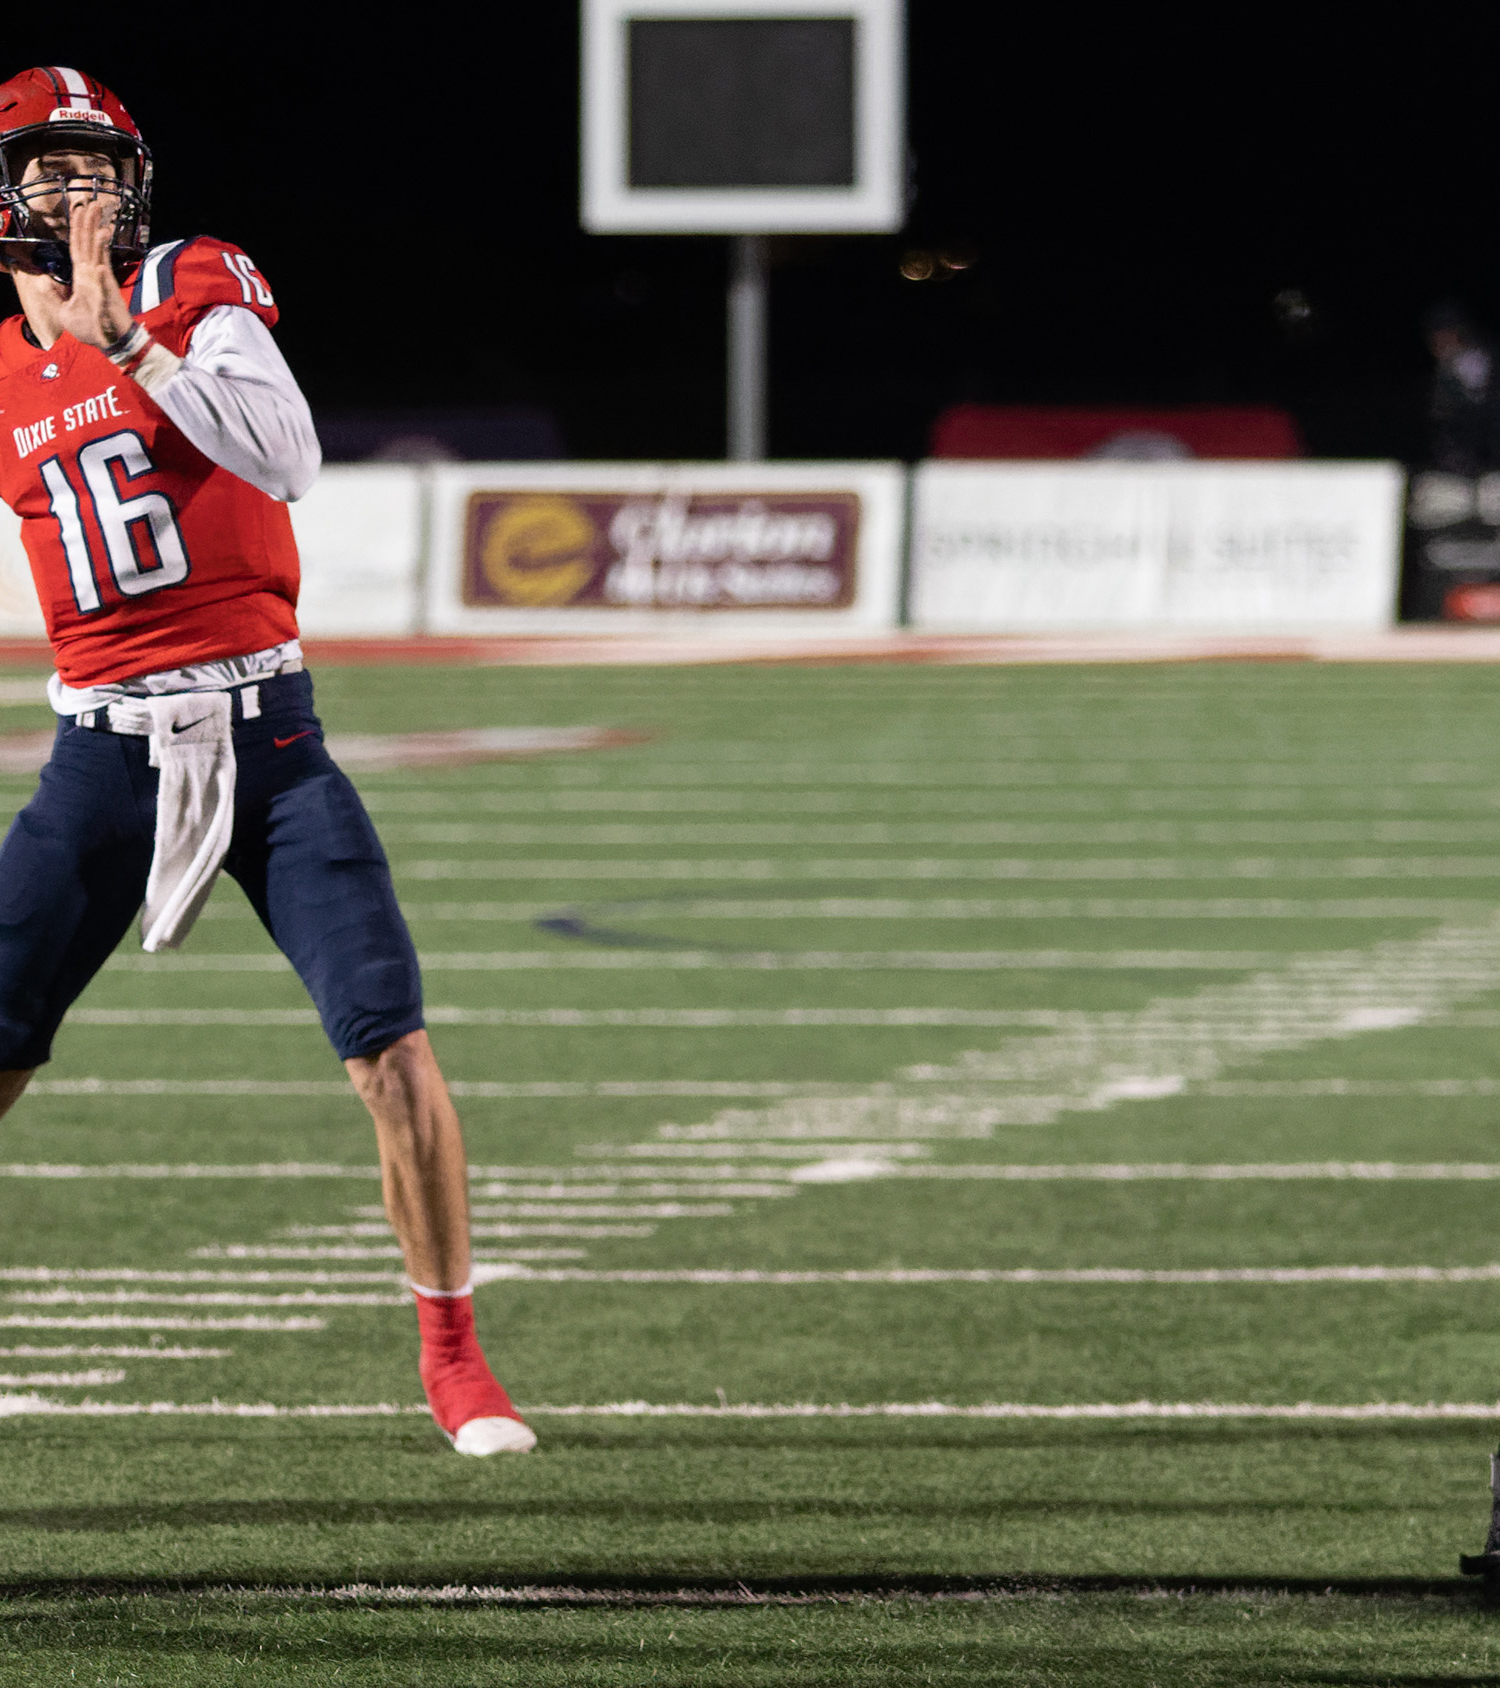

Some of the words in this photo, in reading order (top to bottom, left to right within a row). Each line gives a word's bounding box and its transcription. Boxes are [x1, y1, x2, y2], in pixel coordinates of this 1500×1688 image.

[58, 110, 105, 121] Riddell
[220, 250, 275, 308] 16
[12, 415, 57, 459] DIXIE
[62, 385, 124, 432] STATE
[37, 428, 192, 616] 16
